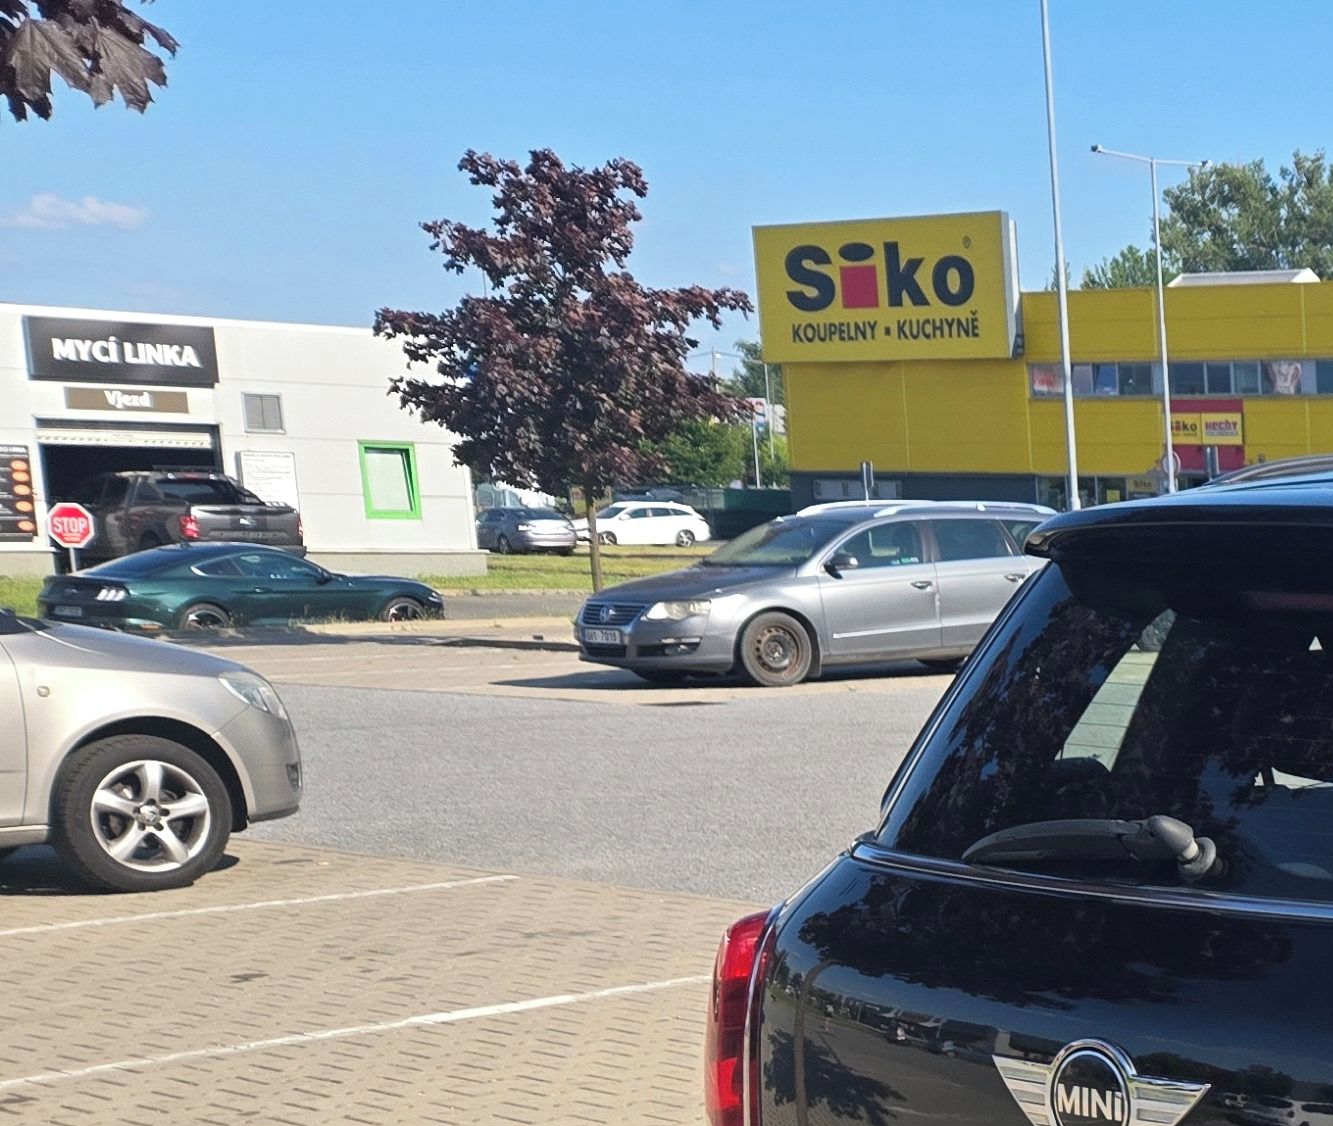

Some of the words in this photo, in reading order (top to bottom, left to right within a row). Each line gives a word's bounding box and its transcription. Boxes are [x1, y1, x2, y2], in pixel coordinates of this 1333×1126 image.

[792, 320, 878, 343] KOUPELNY
[897, 310, 980, 340] KUCHYNĚ
[123, 341, 202, 368] LINKA
[104, 390, 152, 409] Vjezd
[53, 517, 87, 533] STOP
[1057, 1083, 1123, 1122] MINI
